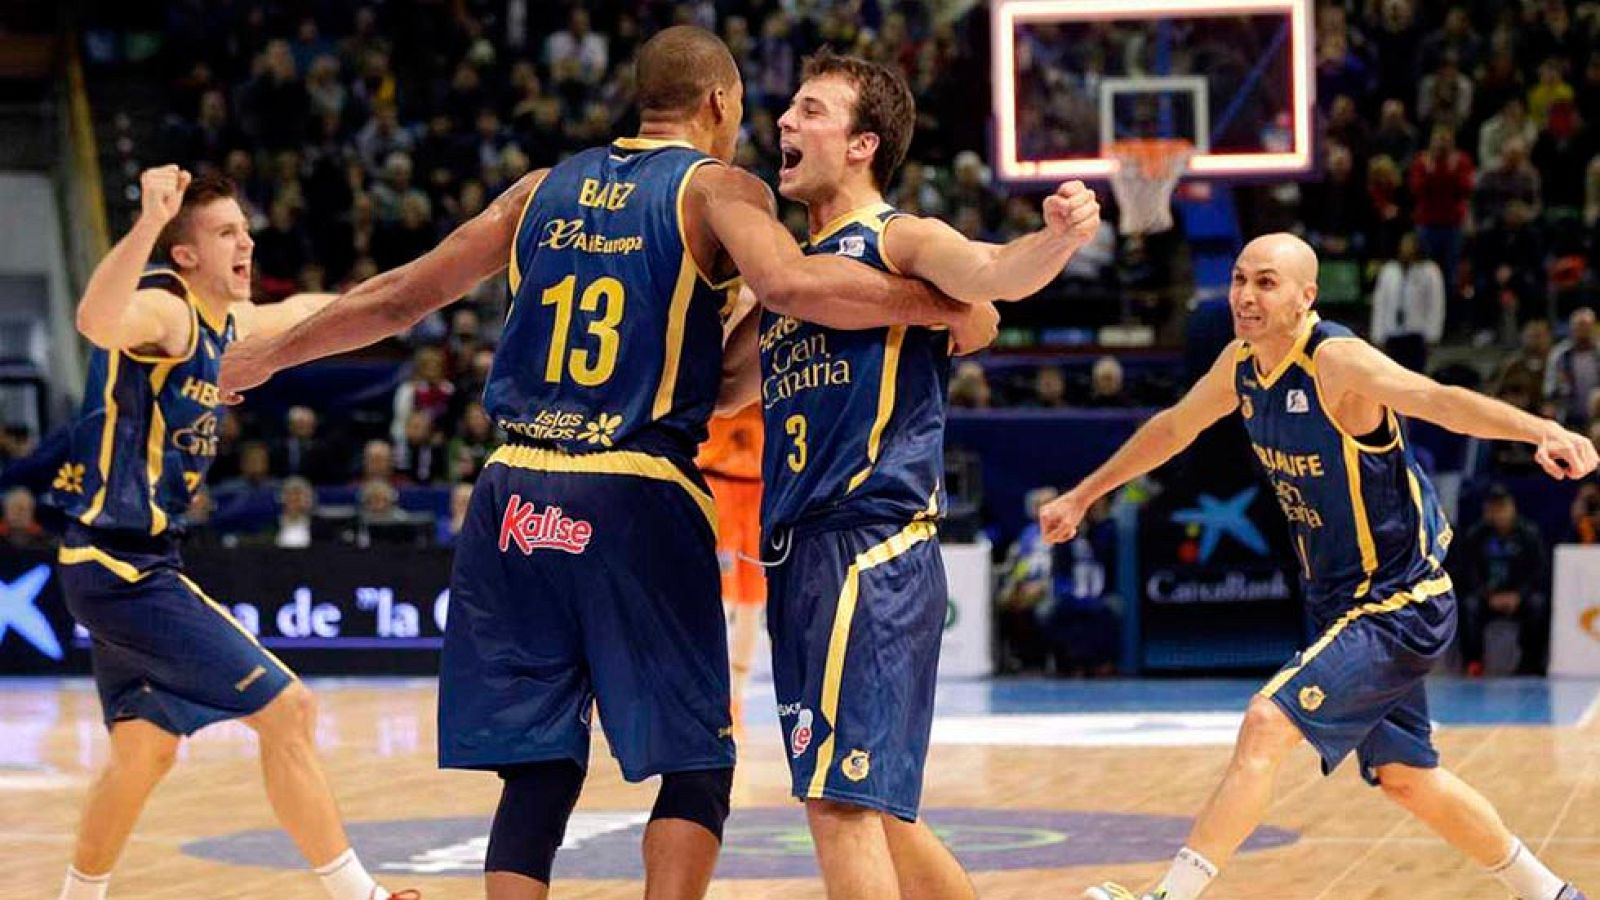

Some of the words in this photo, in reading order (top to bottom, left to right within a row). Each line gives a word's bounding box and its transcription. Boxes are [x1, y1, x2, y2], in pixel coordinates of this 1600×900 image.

[573, 231, 643, 255] AiEuropa
[541, 274, 626, 386] 13
[771, 331, 827, 374] Gan
[785, 413, 808, 474] 3
[498, 494, 592, 556] Kalise
[276, 587, 341, 637] de
